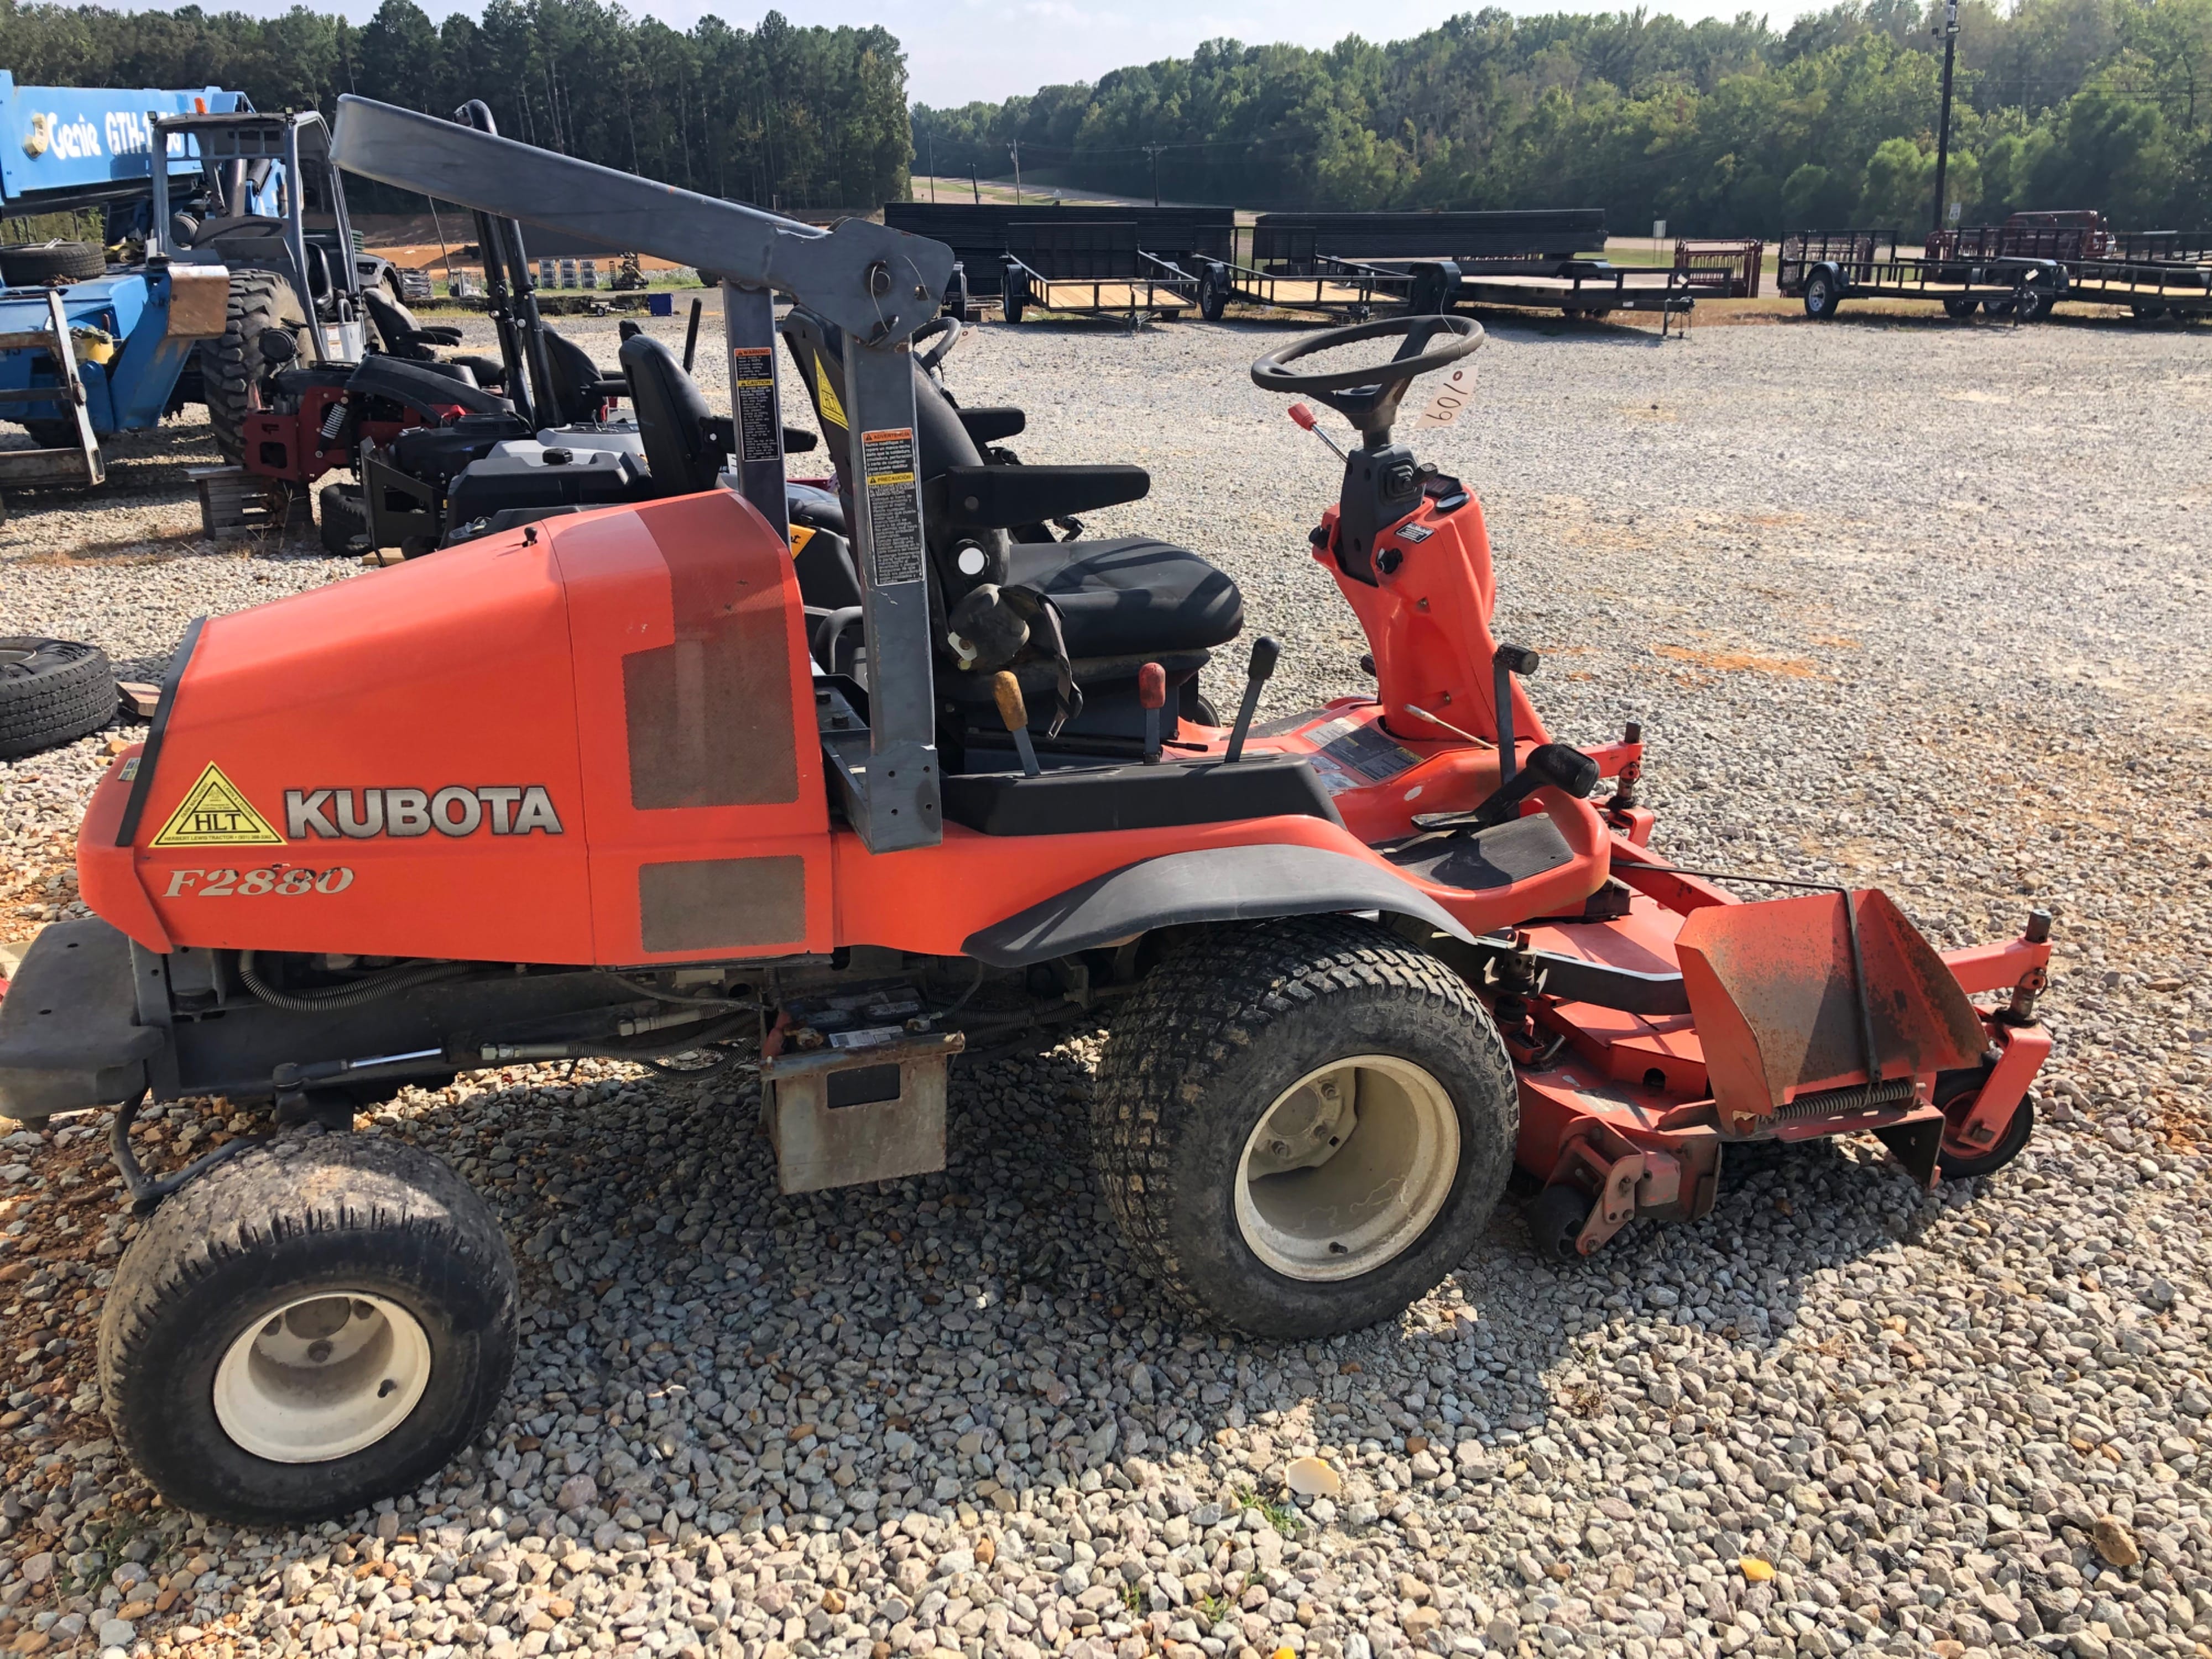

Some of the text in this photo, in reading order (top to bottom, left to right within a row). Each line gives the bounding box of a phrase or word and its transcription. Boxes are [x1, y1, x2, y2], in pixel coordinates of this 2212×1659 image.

[46, 112, 102, 160] Genie
[195, 813, 241, 831] HLT
[284, 785, 564, 838] KUBOTA
[162, 867, 354, 897] F2880
